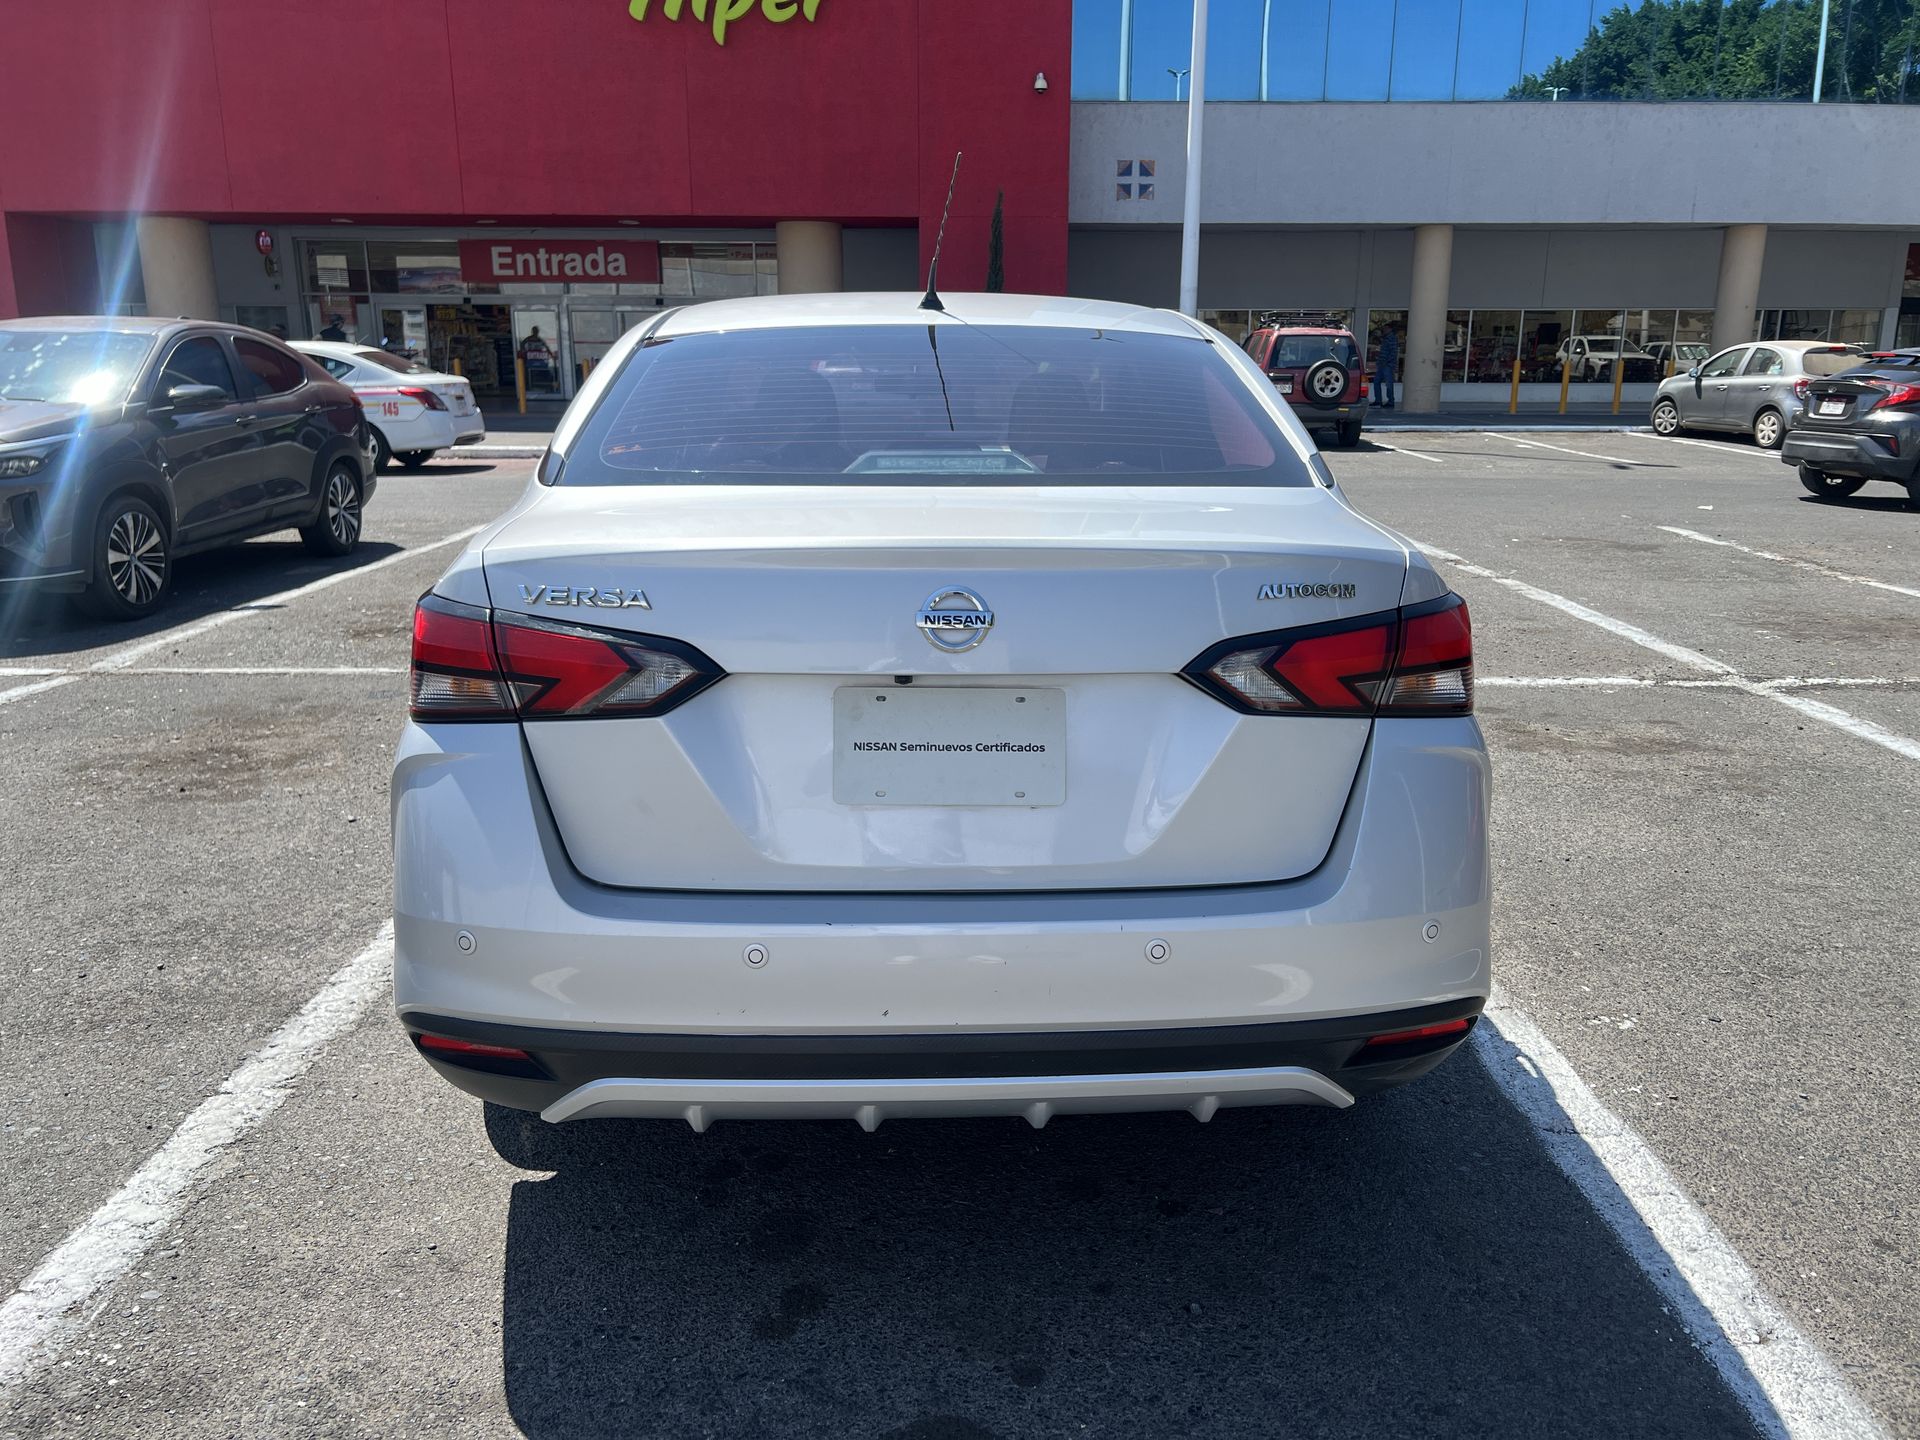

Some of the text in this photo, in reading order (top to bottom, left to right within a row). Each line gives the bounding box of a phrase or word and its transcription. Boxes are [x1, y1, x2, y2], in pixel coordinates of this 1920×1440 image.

[490, 246, 627, 276] Entrada
[382, 401, 399, 416] 145
[518, 584, 653, 610] VERSA
[1257, 584, 1356, 600] AUTOCOM
[924, 615, 986, 625] NISSAN
[853, 742, 1046, 753] NISSAN Seminuevos Certificados
